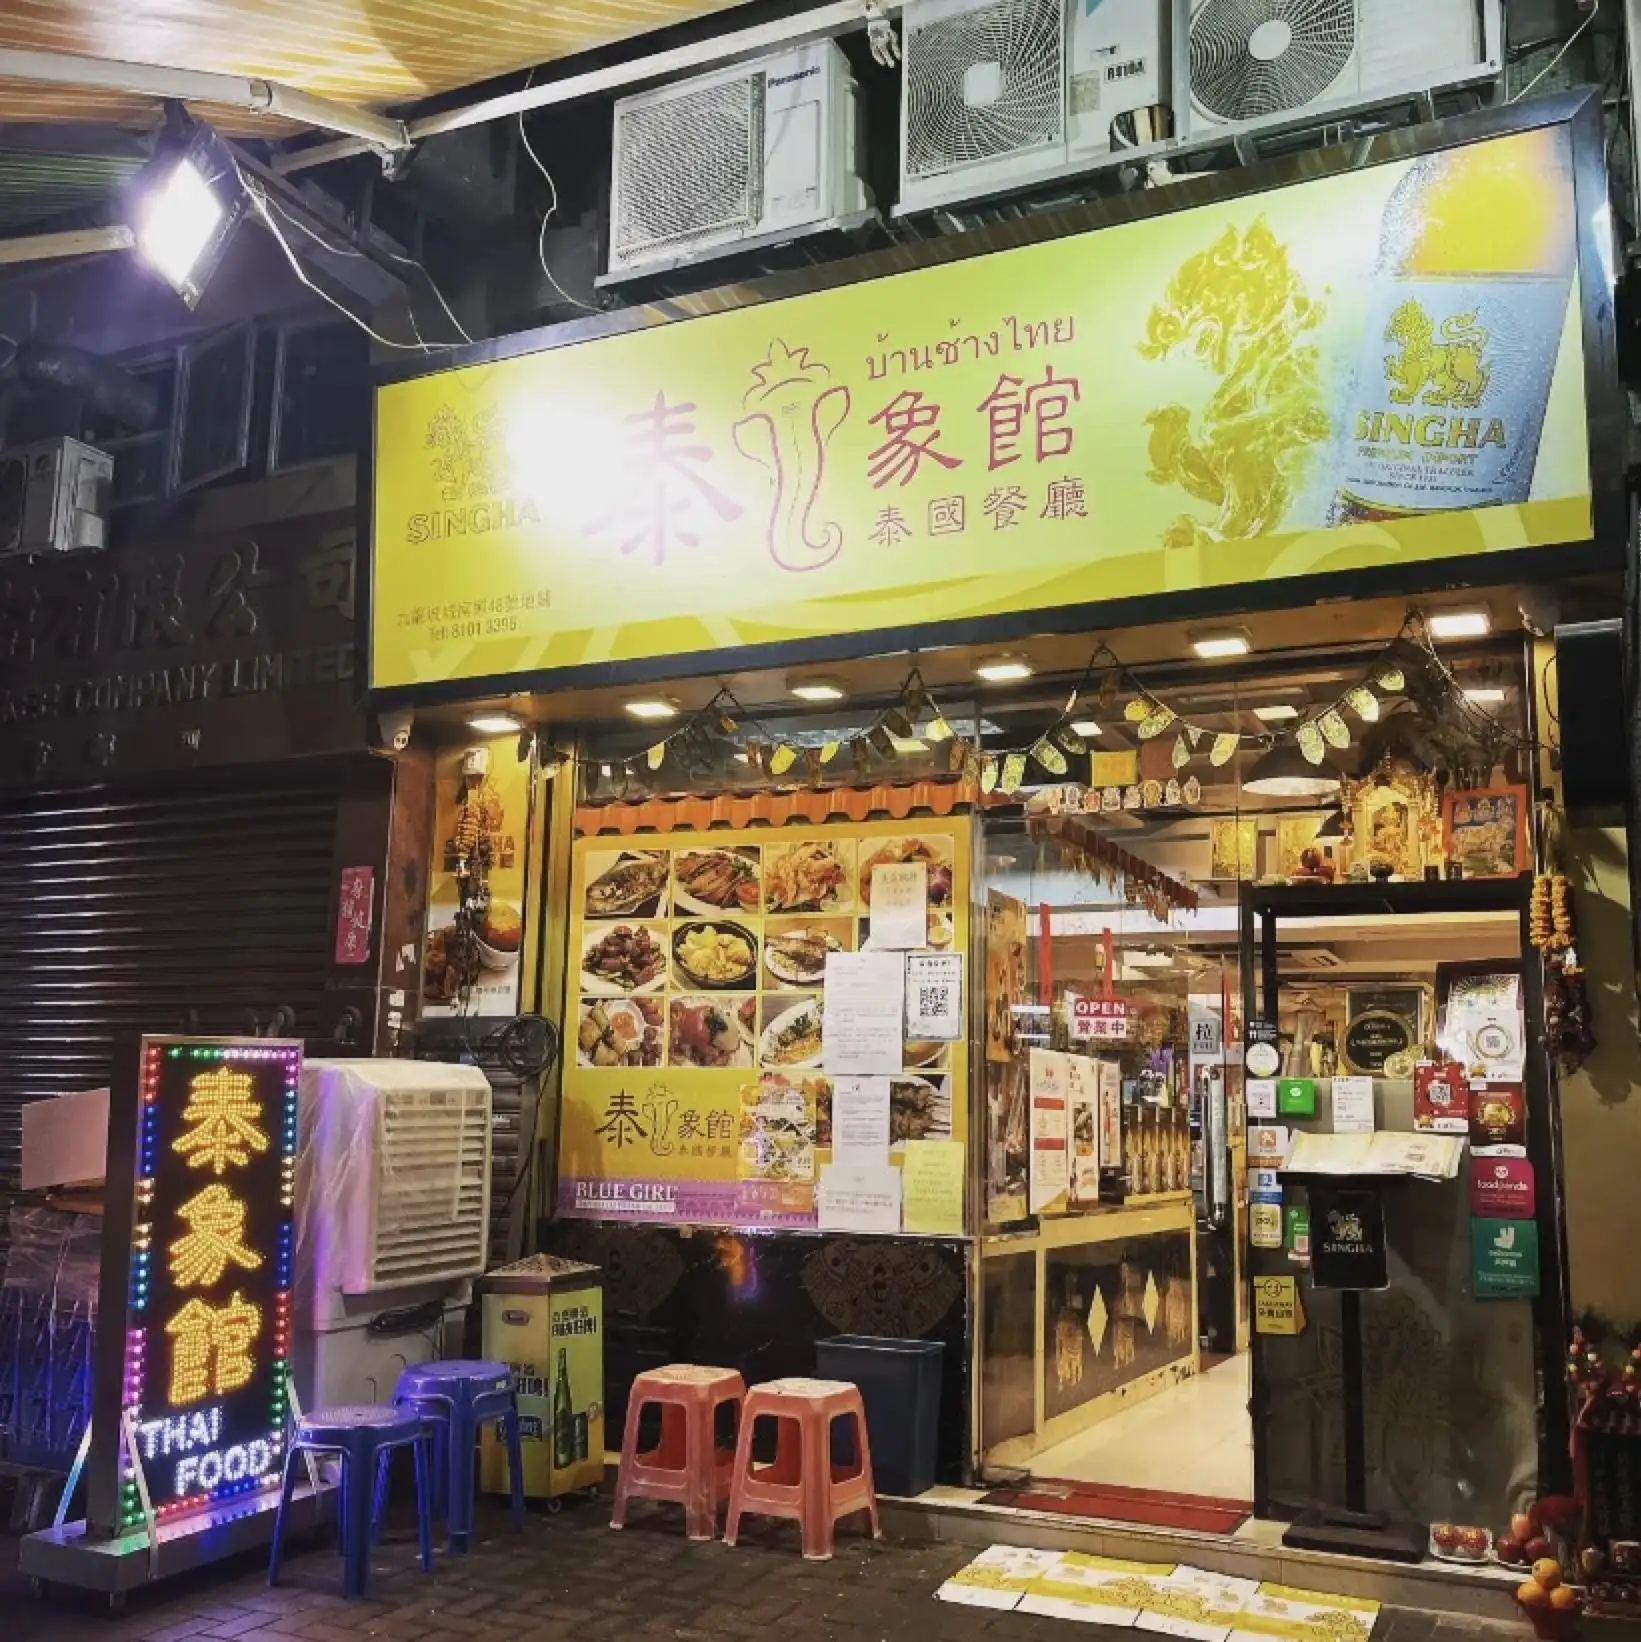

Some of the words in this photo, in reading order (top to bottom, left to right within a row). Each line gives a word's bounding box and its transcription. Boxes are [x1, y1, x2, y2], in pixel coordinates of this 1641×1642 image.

[767, 65, 821, 88] Panasonic
[865, 315, 1075, 380] บ้านช้างไทย
[1353, 411, 1508, 449] SINGHA
[584, 388, 744, 566] 泰
[867, 364, 1081, 489] 象館
[406, 497, 541, 545] SINGHA
[867, 475, 1089, 547] 泰國餐廳
[452, 621, 482, 639] 8101
[1076, 1001, 1125, 1015] OPEN
[594, 1087, 648, 1149] 泰
[678, 1108, 735, 1139] 象館
[576, 1181, 627, 1200] BLUE
[629, 1183, 676, 1202] GIRL
[166, 1065, 269, 1407] 泰象館
[141, 1406, 222, 1459] THAI
[175, 1437, 274, 1497] FOOD
